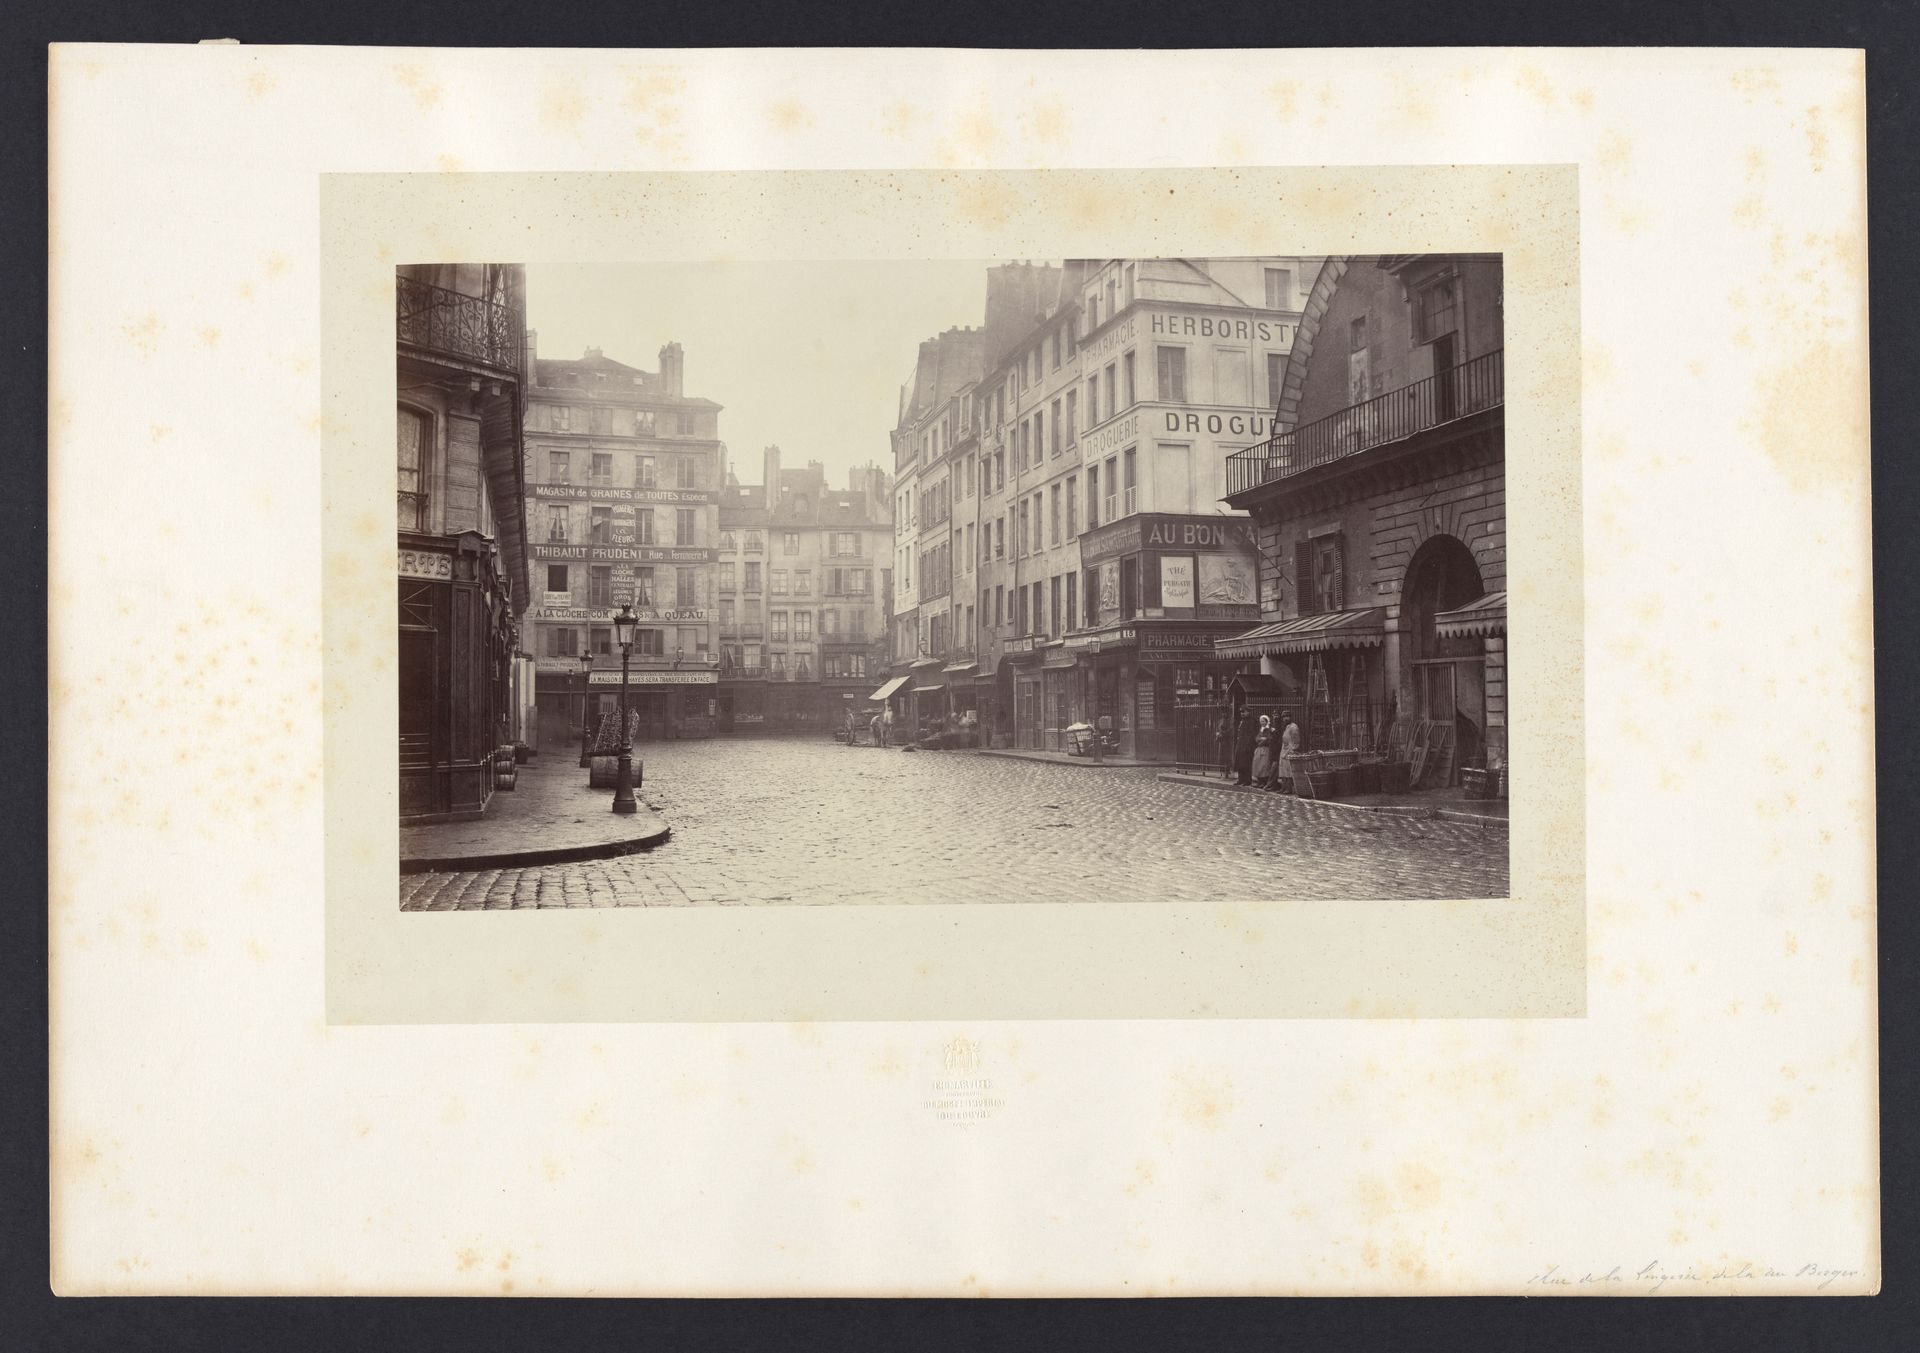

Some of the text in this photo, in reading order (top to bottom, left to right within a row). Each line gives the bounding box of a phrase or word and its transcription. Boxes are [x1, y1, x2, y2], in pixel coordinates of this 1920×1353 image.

[1087, 415, 1139, 458] DROGUERIE
[536, 486, 575, 497] MAGASIN
[577, 488, 587, 497] de
[591, 489, 632, 499] GRAINES
[634, 491, 644, 499] de
[646, 491, 679, 500] TOUTES
[1148, 523, 1176, 544] AU
[1184, 524, 1225, 545] BON
[535, 546, 588, 558] THIBAULT
[592, 548, 642, 559] PRUDENT
[536, 609, 542, 617] A
[556, 610, 588, 618] CLOCHE
